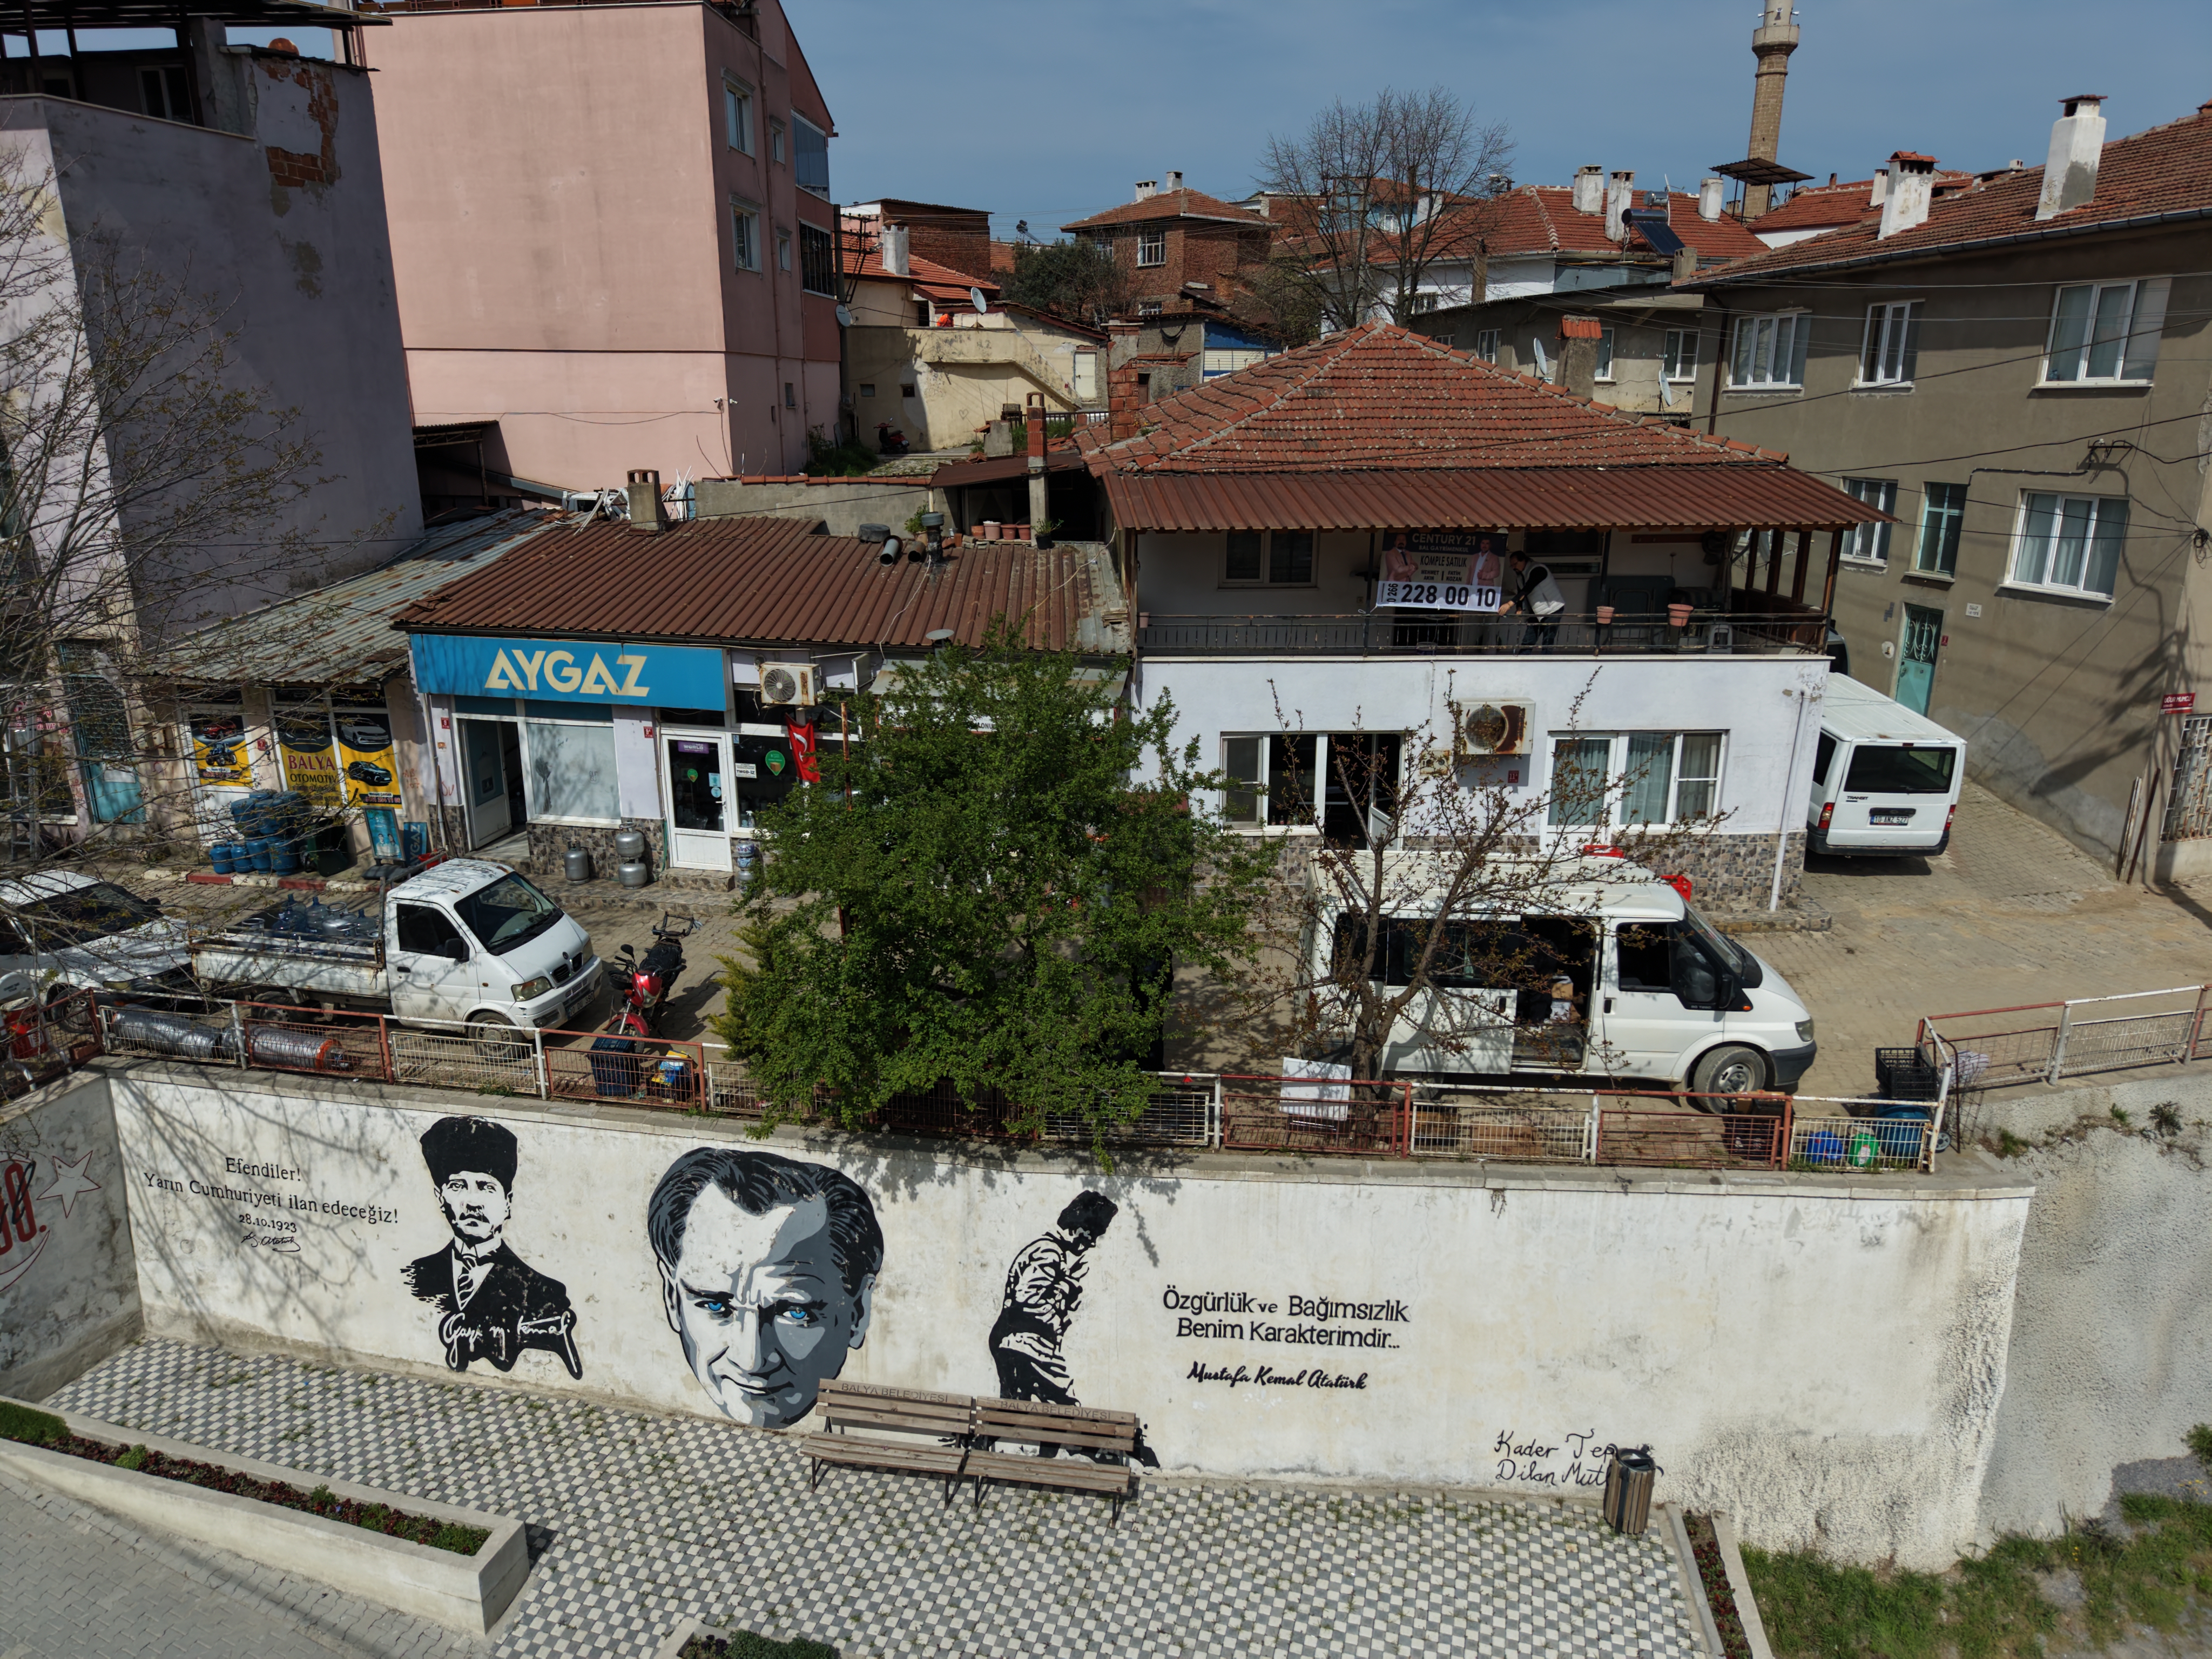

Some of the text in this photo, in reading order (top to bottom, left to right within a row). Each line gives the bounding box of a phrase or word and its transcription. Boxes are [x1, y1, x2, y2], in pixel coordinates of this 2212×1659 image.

[1412, 533, 1476, 545] CENTURY 21
[1420, 555, 1467, 567] KOMPLE SATILIK
[1387, 583, 1398, 597] 266
[1401, 584, 1496, 607] 228 00 10
[484, 648, 650, 697] AYGAZ
[287, 755, 336, 771] BALYA
[225, 1157, 301, 1182] Efendiler!
[144, 1172, 399, 1225] Yarın Cumhuriyeti ilan edeceğiz!
[239, 1213, 297, 1232] 28.10.1923
[1163, 1284, 1411, 1323] Özgürlük ve Bağımsızlık
[1176, 1317, 1400, 1349] Benim Karakterimdir...
[1186, 1361, 1368, 1390] Mustafa Kemal Atatürk
[841, 1382, 948, 1403] BALYA BELEDİYESİ
[1001, 1400, 1111, 1420] BALYA BELEDİYESİ
[1494, 1429, 1560, 1458] Kader
[1495, 1459, 1556, 1485] Dilan
